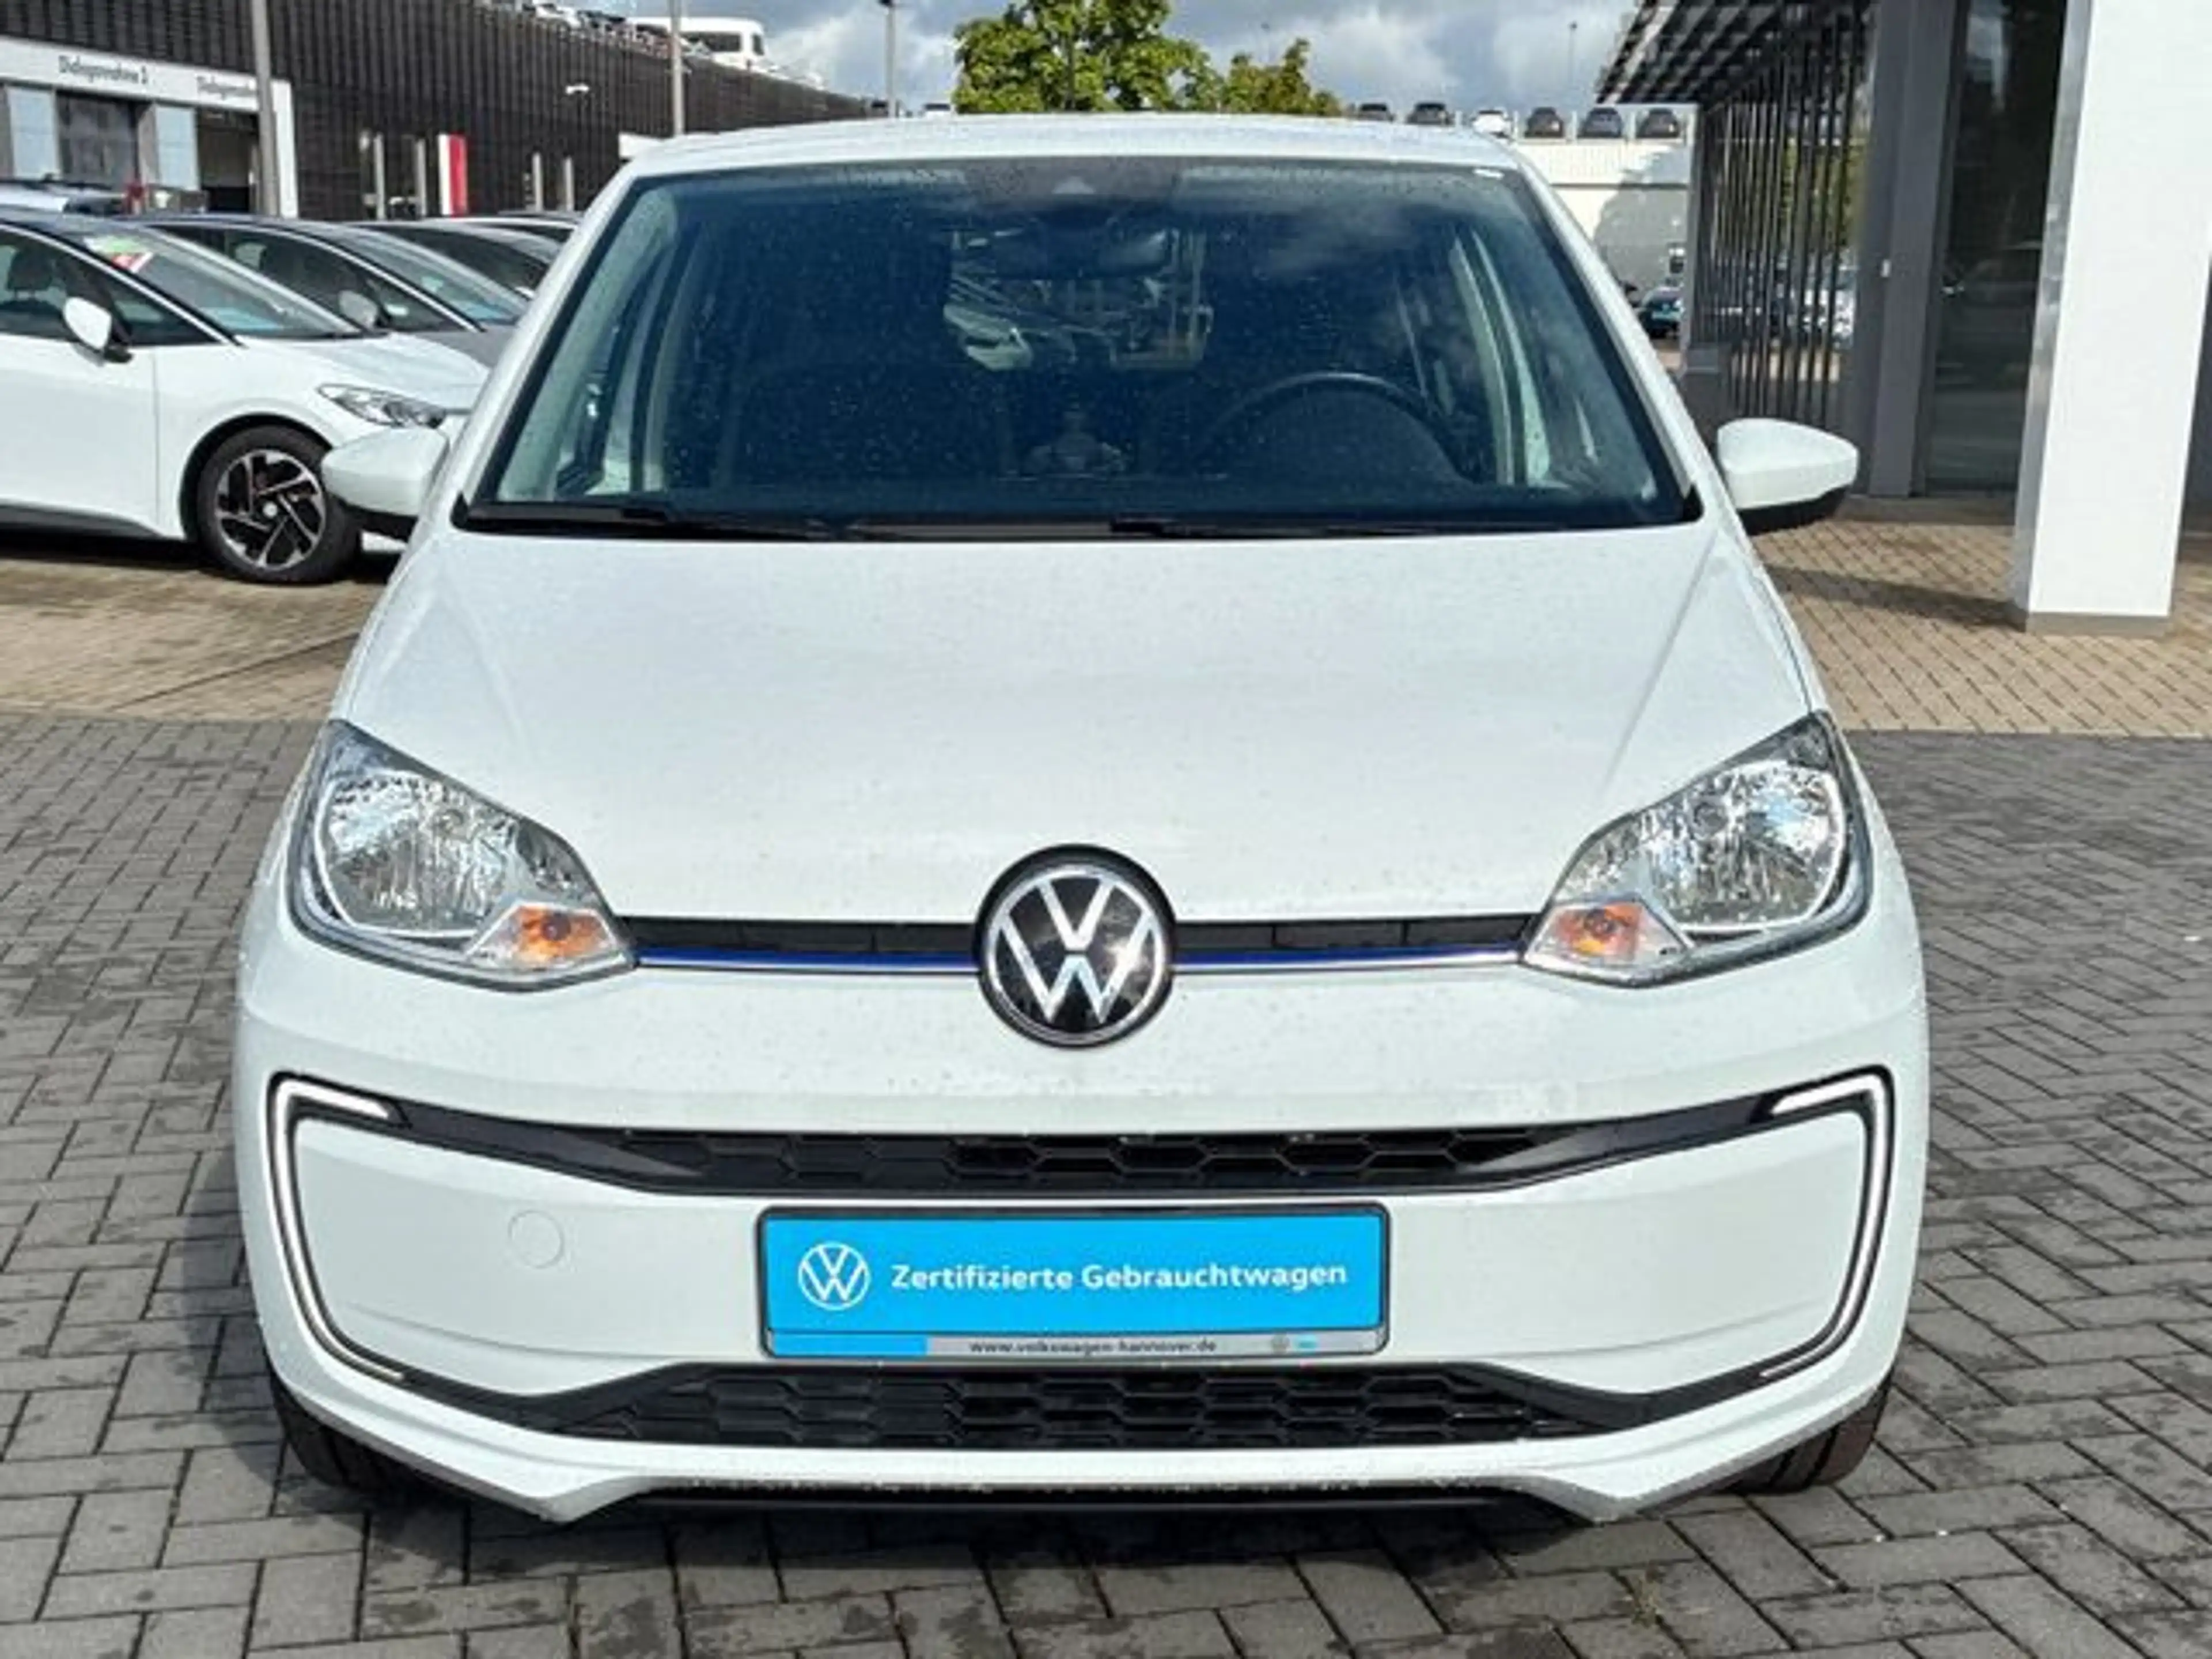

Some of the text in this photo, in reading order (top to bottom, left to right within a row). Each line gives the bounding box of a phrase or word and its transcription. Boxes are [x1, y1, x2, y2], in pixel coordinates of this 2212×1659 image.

[990, 871, 1161, 1028] VW
[800, 1243, 870, 1305] VW
[891, 1263, 1347, 1292] Zertifizierte Gebrauchtwagen
